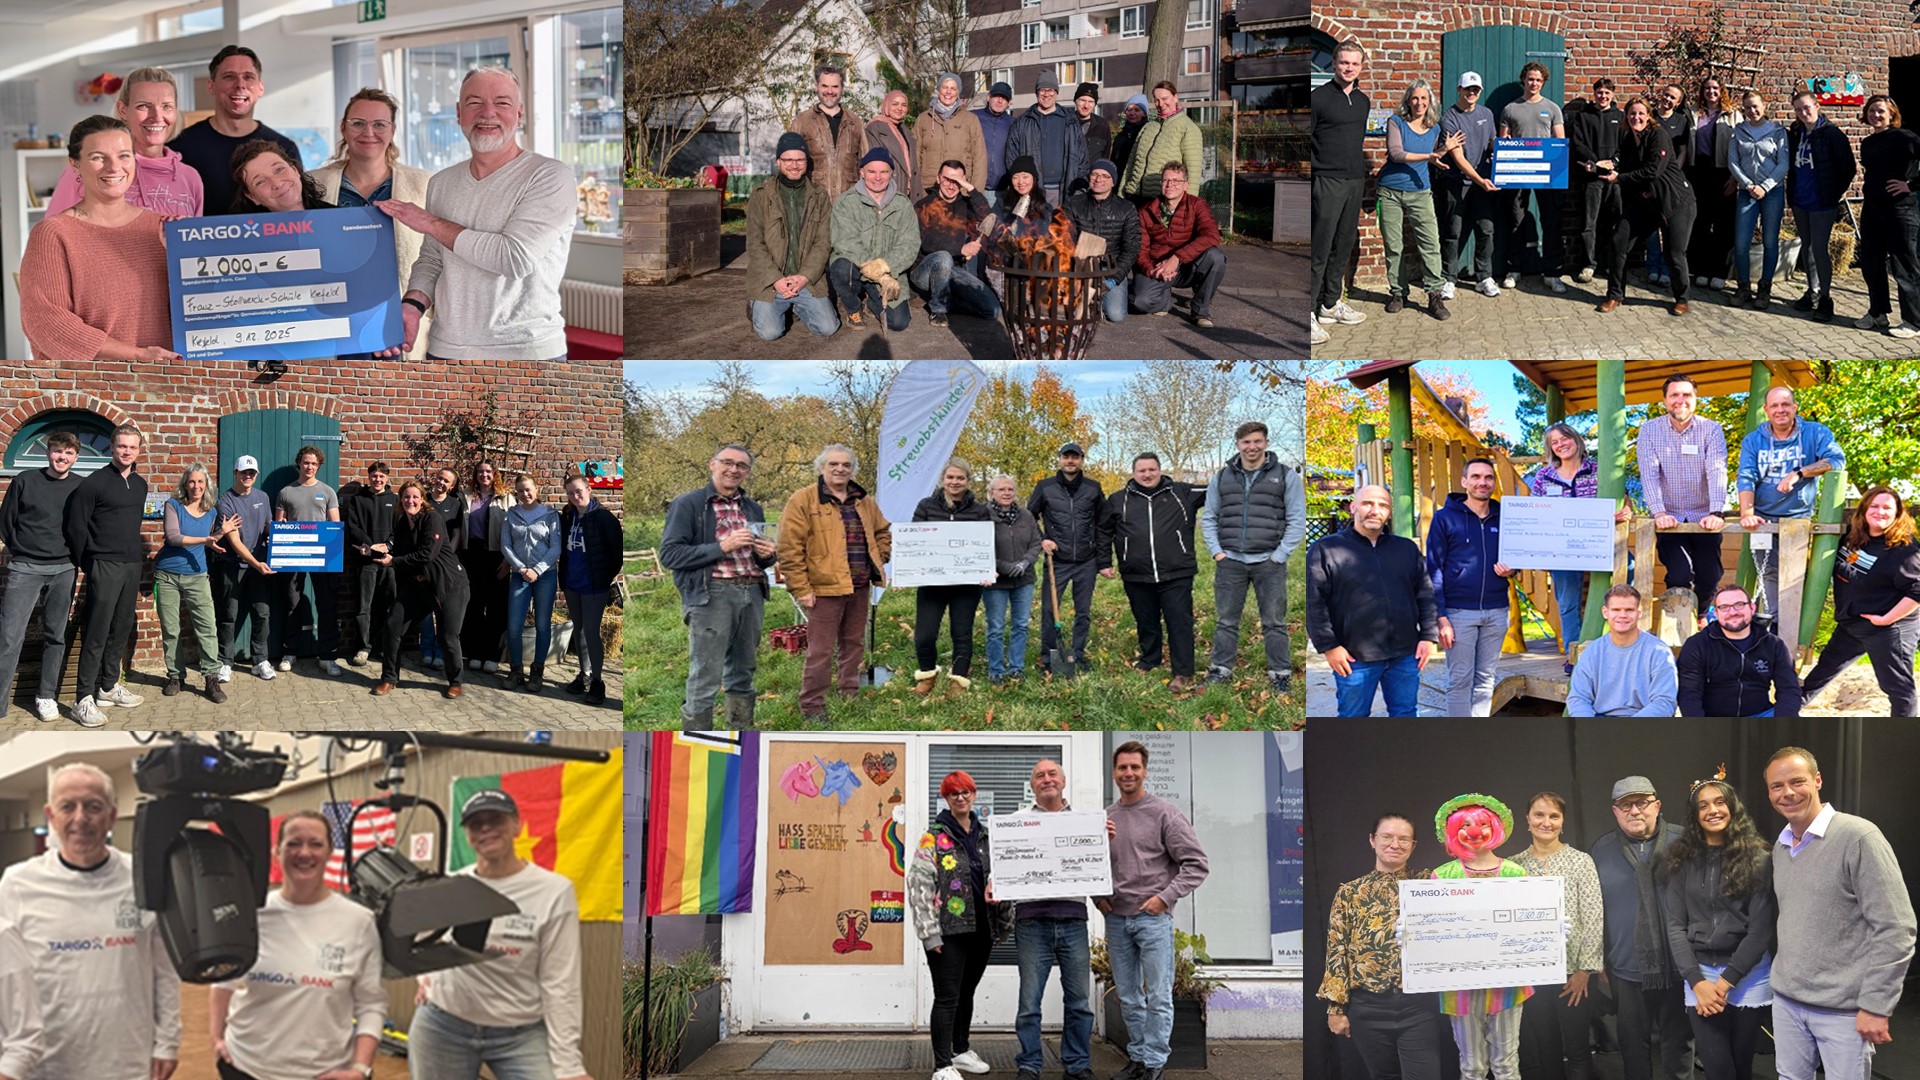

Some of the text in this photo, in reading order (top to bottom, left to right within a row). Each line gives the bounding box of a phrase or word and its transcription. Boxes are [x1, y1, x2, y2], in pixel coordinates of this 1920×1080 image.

[178, 221, 314, 241] TARGO BANK
[888, 381, 965, 481] Streuobstkinder
[779, 824, 804, 837] HASS
[779, 837, 806, 849] LIEBE
[1410, 889, 1440, 897] TARGO
[105, 936, 137, 947] BANK
